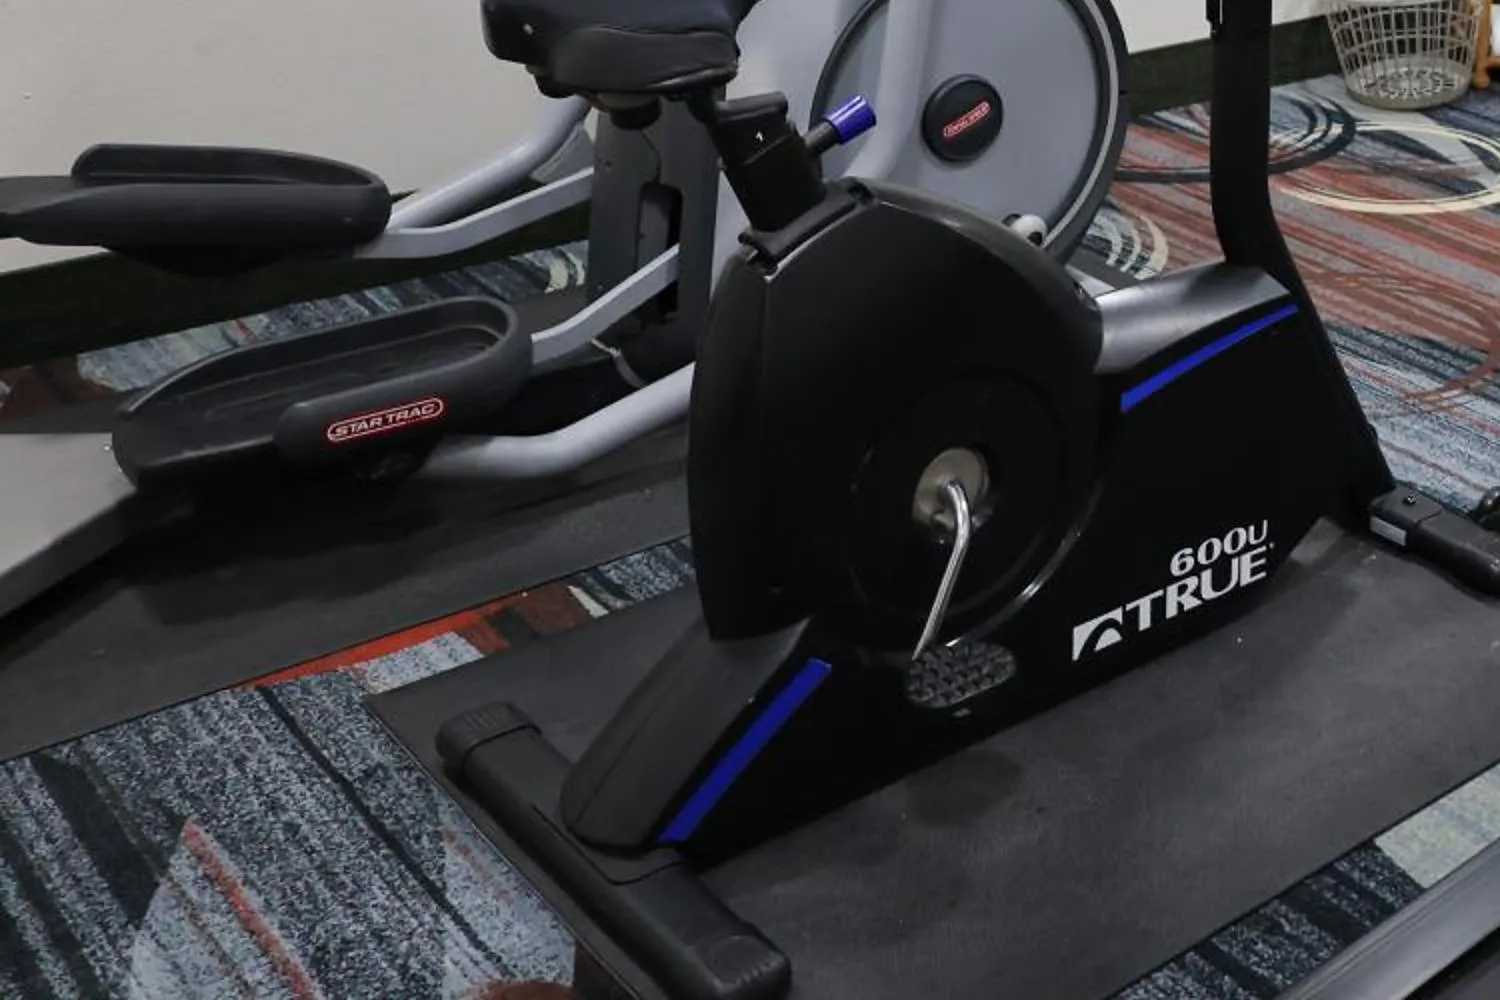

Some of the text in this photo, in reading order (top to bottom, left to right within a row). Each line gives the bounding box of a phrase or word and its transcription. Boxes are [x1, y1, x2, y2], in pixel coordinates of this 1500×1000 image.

[334, 403, 437, 437] STAR TRAC
[1169, 519, 1268, 577] 600U
[1125, 546, 1268, 632] TRUE
